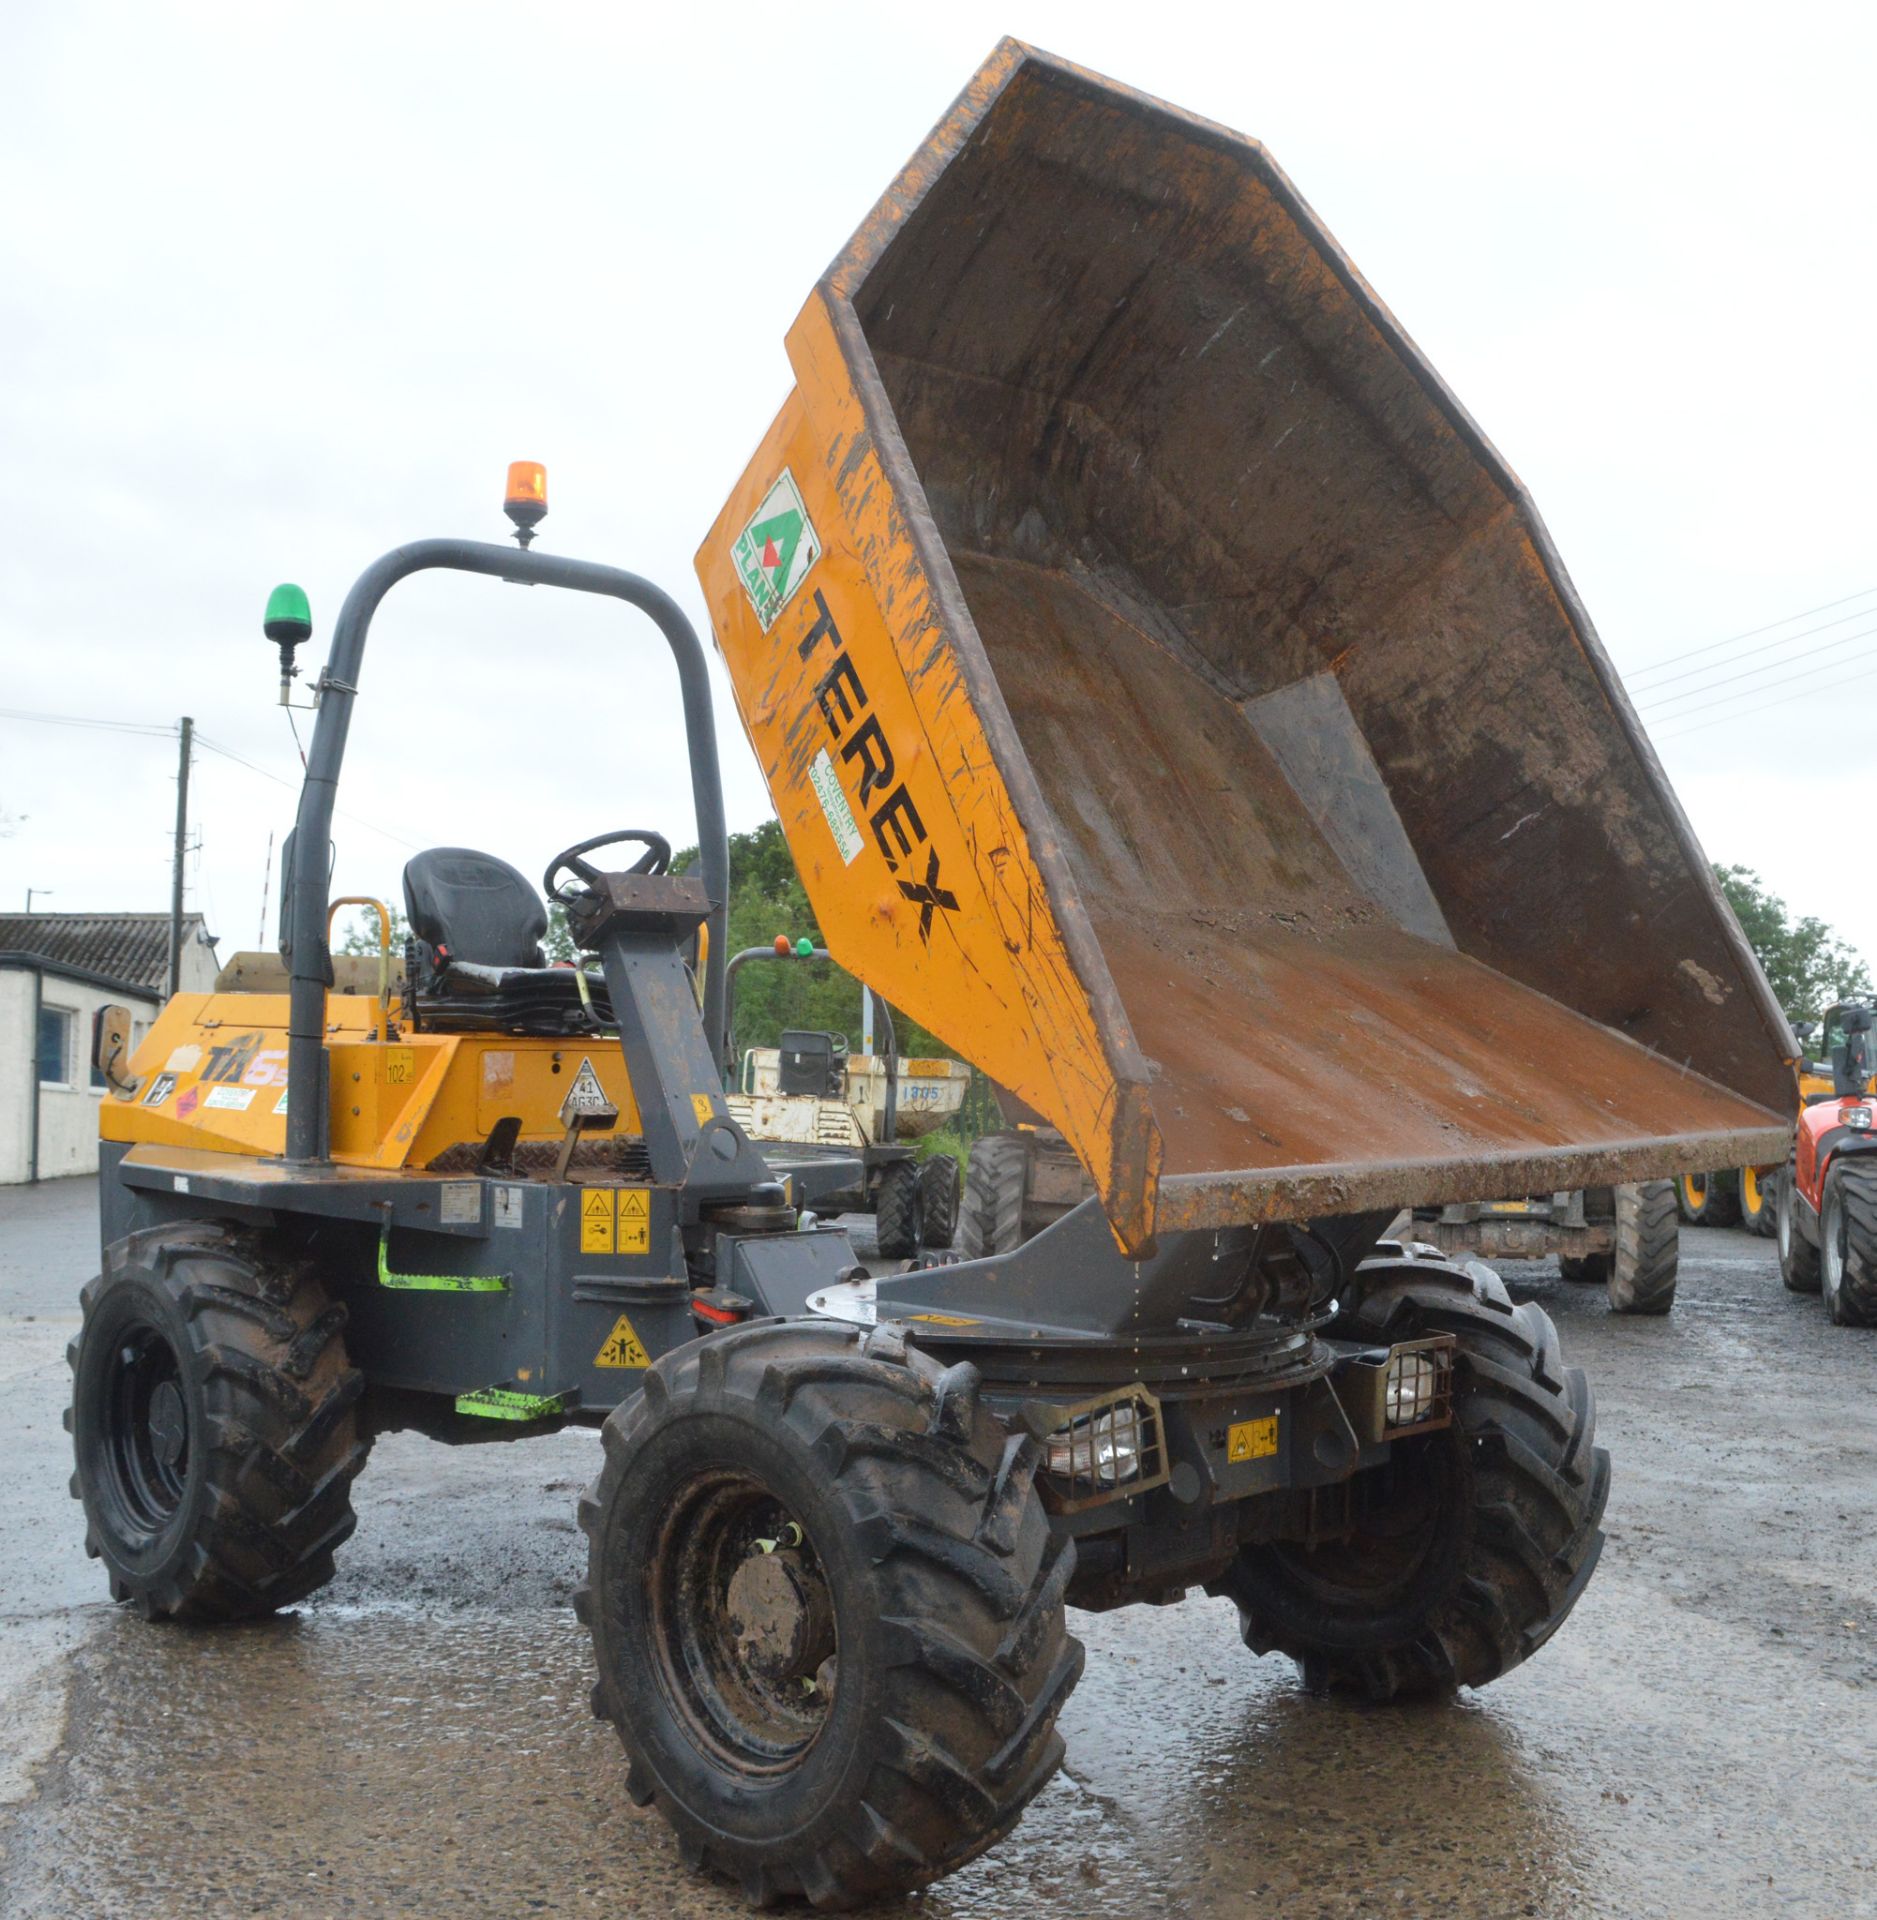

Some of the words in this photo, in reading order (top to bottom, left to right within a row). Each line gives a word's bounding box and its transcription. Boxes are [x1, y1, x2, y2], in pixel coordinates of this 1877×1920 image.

[797, 587, 961, 947] TEREX
[824, 764, 857, 836] COVENTRY
[388, 1064, 404, 1083] 102
